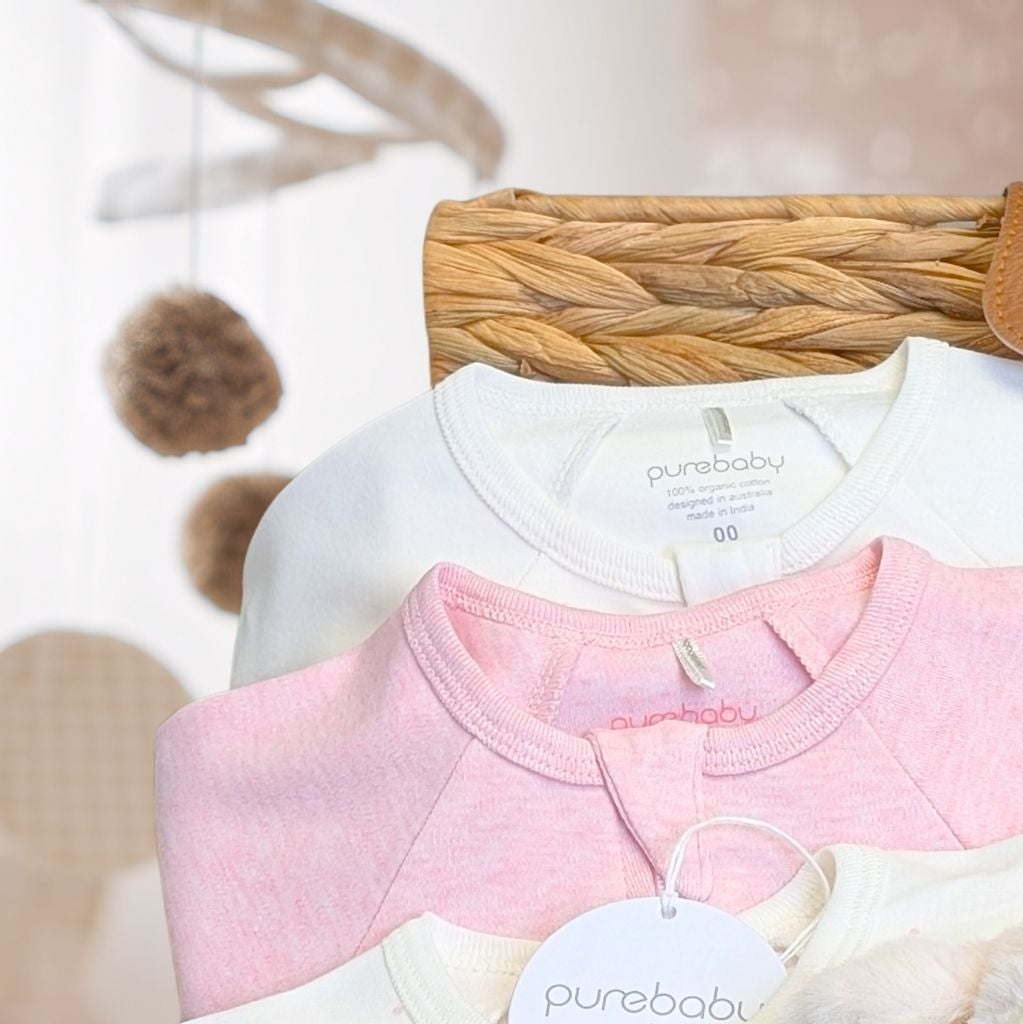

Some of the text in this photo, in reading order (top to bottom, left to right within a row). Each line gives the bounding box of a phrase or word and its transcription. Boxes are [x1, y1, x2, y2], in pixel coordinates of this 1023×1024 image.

[646, 451, 785, 488] purebaby
[667, 478, 771, 497] 100% organic cotton
[667, 489, 773, 510] designed in australia
[686, 510, 715, 521] made
[718, 508, 728, 516] in
[713, 524, 739, 543] 00
